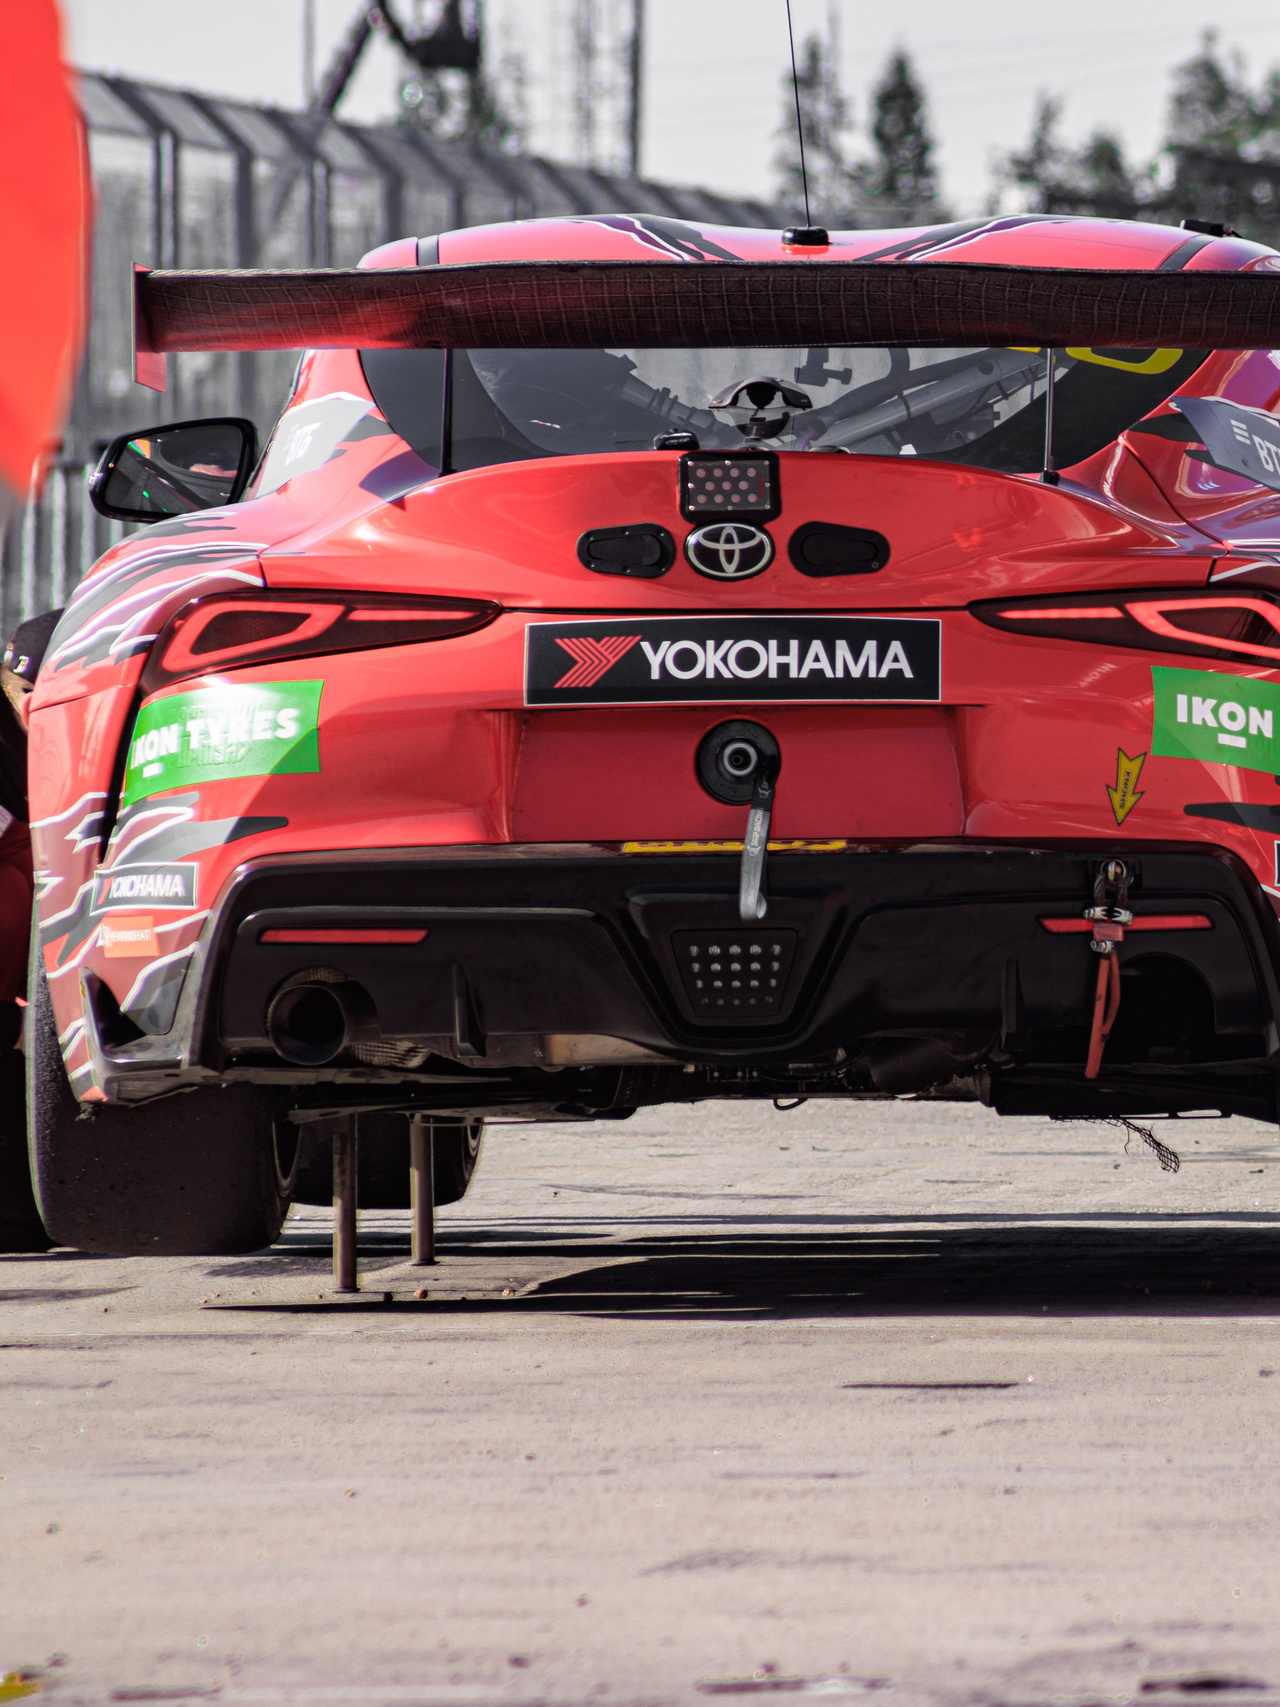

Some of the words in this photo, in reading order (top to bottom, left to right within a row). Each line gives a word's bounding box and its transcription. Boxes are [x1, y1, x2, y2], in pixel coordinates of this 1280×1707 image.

[640, 640, 914, 679] YOKOHAMA
[186, 708, 300, 749] TYRES
[1176, 694, 1273, 738] IKON
